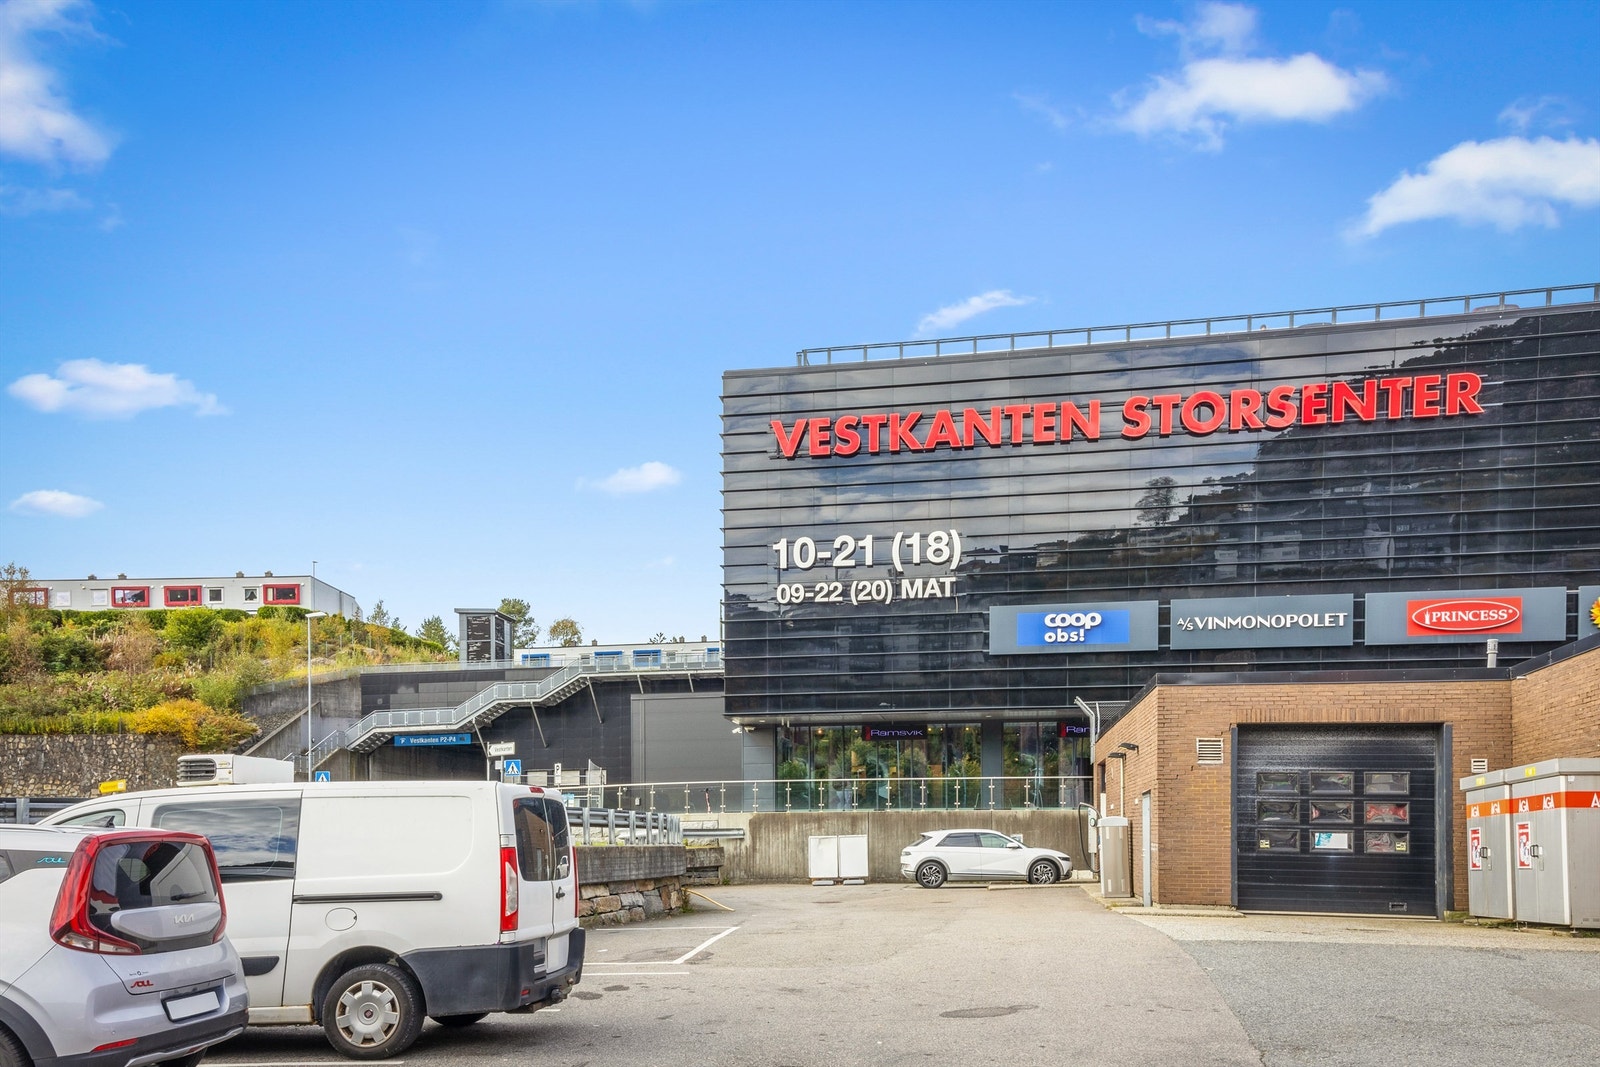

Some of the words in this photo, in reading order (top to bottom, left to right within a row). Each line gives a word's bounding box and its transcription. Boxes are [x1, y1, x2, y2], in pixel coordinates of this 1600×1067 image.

[771, 400, 1101, 458] VESTKANTEN
[1122, 372, 1485, 438] STORSENTER
[773, 535, 873, 570] 10-21
[892, 529, 961, 571] (18)
[776, 582, 843, 604] 09-22
[851, 579, 893, 605] (20)
[901, 577, 956, 599] MAT
[1044, 612, 1102, 629] coop
[1177, 617, 1194, 631] A/S
[1194, 613, 1348, 630] VINMONOPOLET
[1044, 629, 1085, 642] obs!
[1518, 798, 1529, 812] AGA
[1543, 794, 1554, 809] AGA
